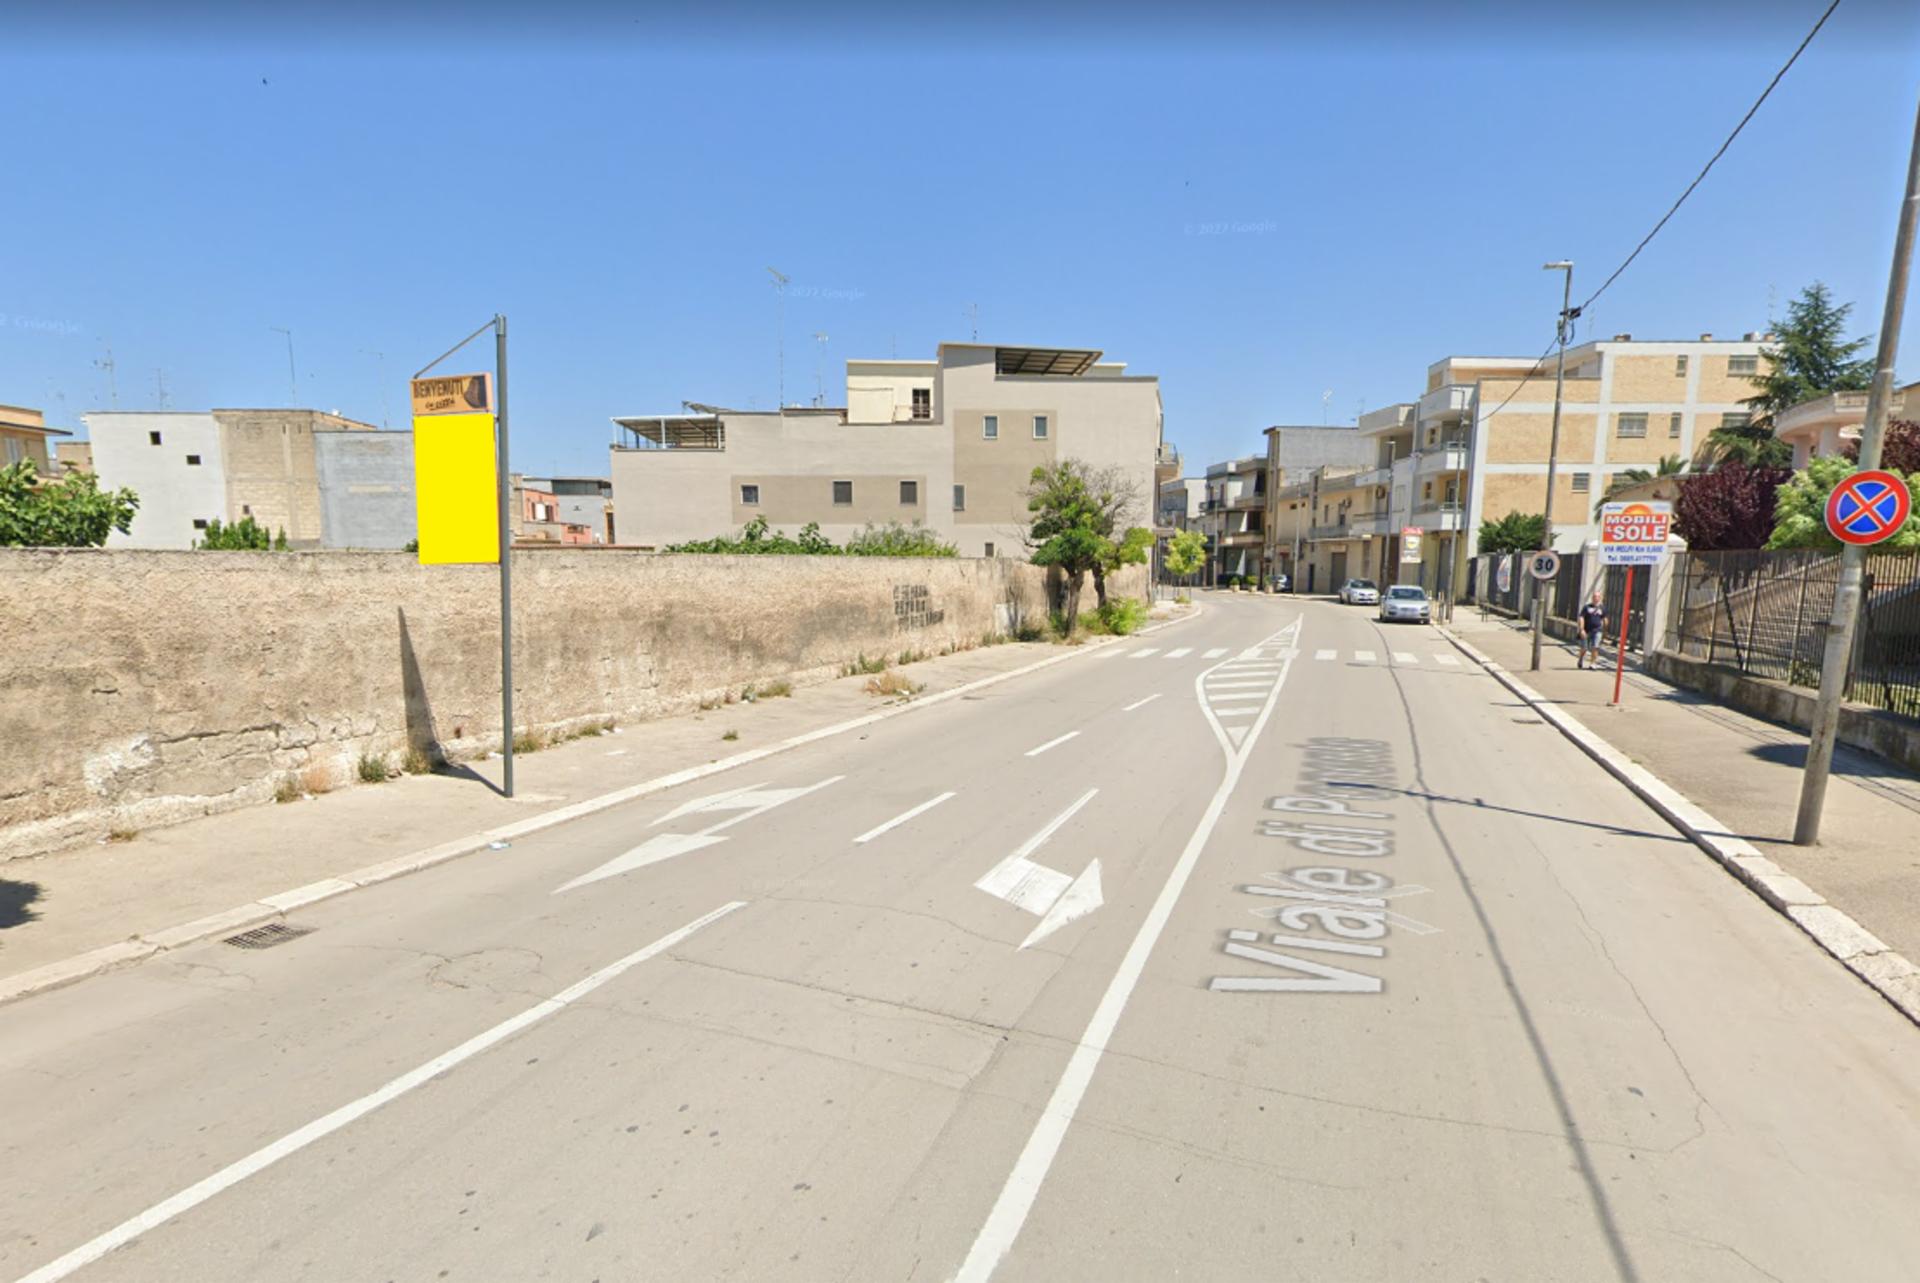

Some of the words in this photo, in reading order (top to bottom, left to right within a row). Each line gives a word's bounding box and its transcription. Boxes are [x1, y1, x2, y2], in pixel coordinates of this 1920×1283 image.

[1606, 515, 1667, 525] MOBILI
[1612, 525, 1666, 541] SOLE
[1535, 558, 1554, 572] 30
